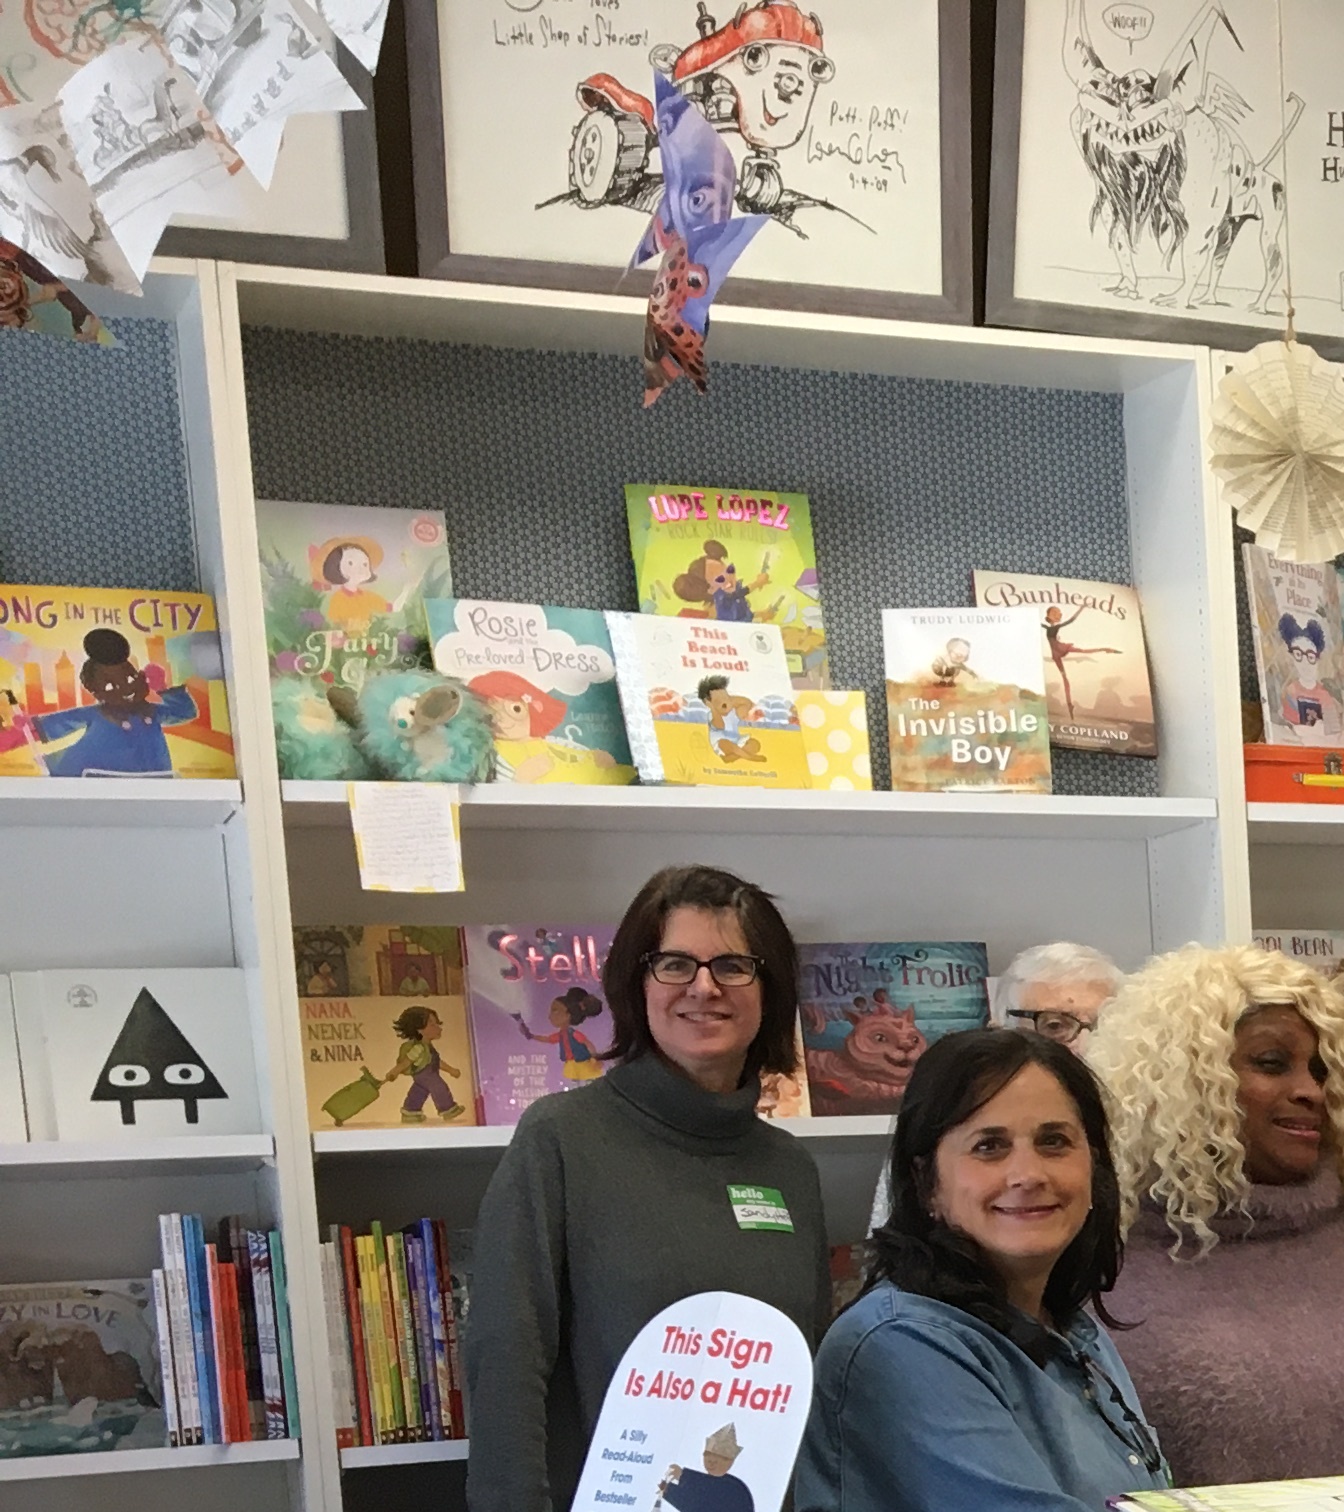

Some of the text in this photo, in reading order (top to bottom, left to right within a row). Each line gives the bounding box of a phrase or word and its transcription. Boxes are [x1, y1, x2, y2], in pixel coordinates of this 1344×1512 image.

[495, 15, 534, 46] Little
[541, 18, 569, 50] Shop
[647, 492, 706, 523] LUPE
[983, 580, 1129, 622] Bunheads
[64, 598, 203, 633] IN THE CITY
[910, 614, 1012, 627] TRUDY LUDWIG
[689, 625, 729, 642] This
[686, 640, 739, 658] Beach
[681, 655, 750, 673] Is Loud!
[907, 697, 941, 712] The
[897, 708, 1040, 738] Invisible
[1059, 725, 1130, 742] COPELAND
[950, 738, 1013, 771] Boy
[891, 949, 985, 991] Frolic
[307, 1022, 366, 1042] NENEK
[323, 1044, 365, 1062] NINA
[731, 1186, 763, 1201] hello
[60, 1301, 121, 1330] LOVE
[662, 1324, 774, 1371] This Sign
[624, 1367, 793, 1414] Is Also a Hat!
[620, 1429, 649, 1446] A Silly
[600, 1447, 655, 1466] Read-Aloud
[609, 1470, 634, 1485] From
[593, 1489, 638, 1507] Bestseller
